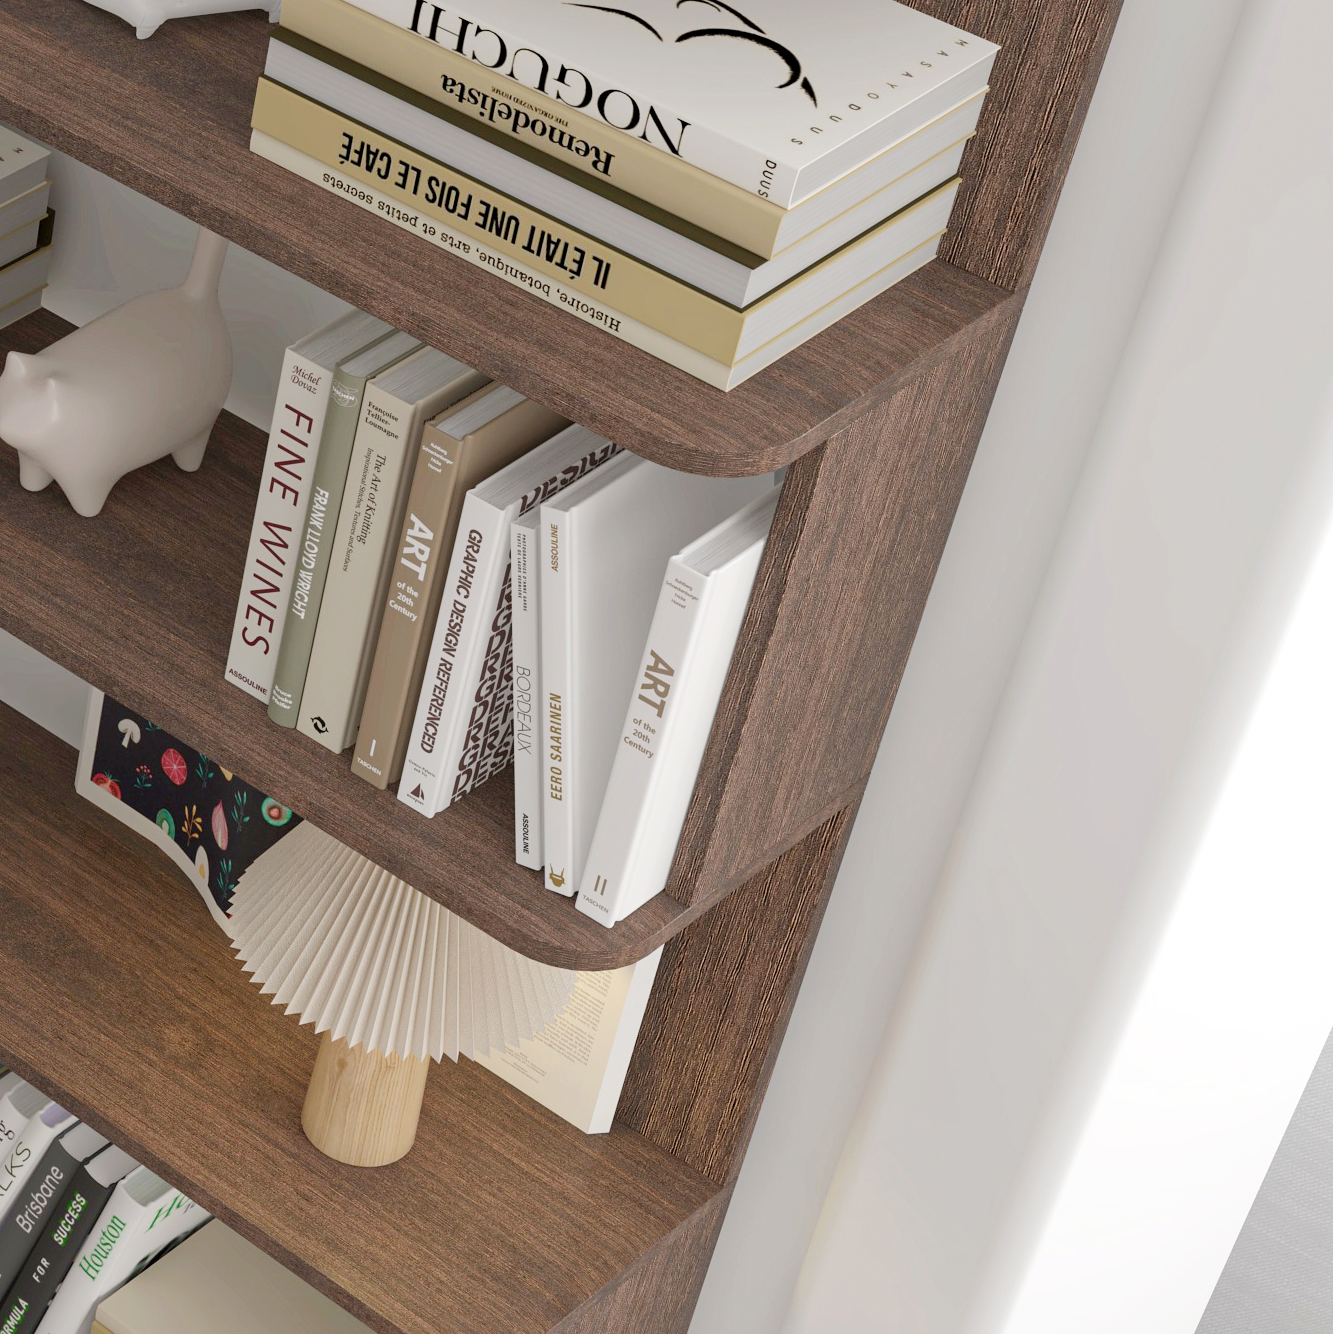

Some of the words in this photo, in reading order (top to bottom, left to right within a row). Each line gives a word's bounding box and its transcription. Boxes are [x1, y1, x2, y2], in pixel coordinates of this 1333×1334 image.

[441, 74, 615, 178] Remodelista
[338, 131, 392, 180] CAFÉ
[395, 160, 422, 195] LE
[757, 158, 777, 199] DUUS
[323, 173, 373, 205] secrets
[378, 201, 418, 228] petits
[425, 176, 472, 221] FOIS
[422, 220, 436, 236] et
[441, 232, 470, 255] arts
[475, 199, 520, 244] UNE
[476, 246, 551, 297] botanique,
[522, 225, 586, 281] ÉTAIT
[592, 255, 611, 290] IL
[556, 284, 621, 332] Histoire,
[269, 403, 314, 506] FINE
[309, 486, 329, 531] FRANK
[302, 529, 320, 569] LLOYD
[400, 513, 434, 582] ART
[456, 529, 483, 599] GRAPHIC
[242, 520, 292, 655] WINES
[292, 568, 314, 619] WRIGHT
[443, 599, 467, 658] DESIGN
[421, 657, 453, 754] REFERENCED
[638, 649, 675, 718] ART
[516, 665, 532, 754] BORDEAUX
[550, 693, 563, 762] SAARINEN
[550, 765, 563, 802] EERO
[16, 1165, 63, 1234] Brisbane
[33, 1257, 50, 1283] FOR
[53, 1193, 87, 1247] SUCCESS
[79, 1214, 126, 1282] Houston
